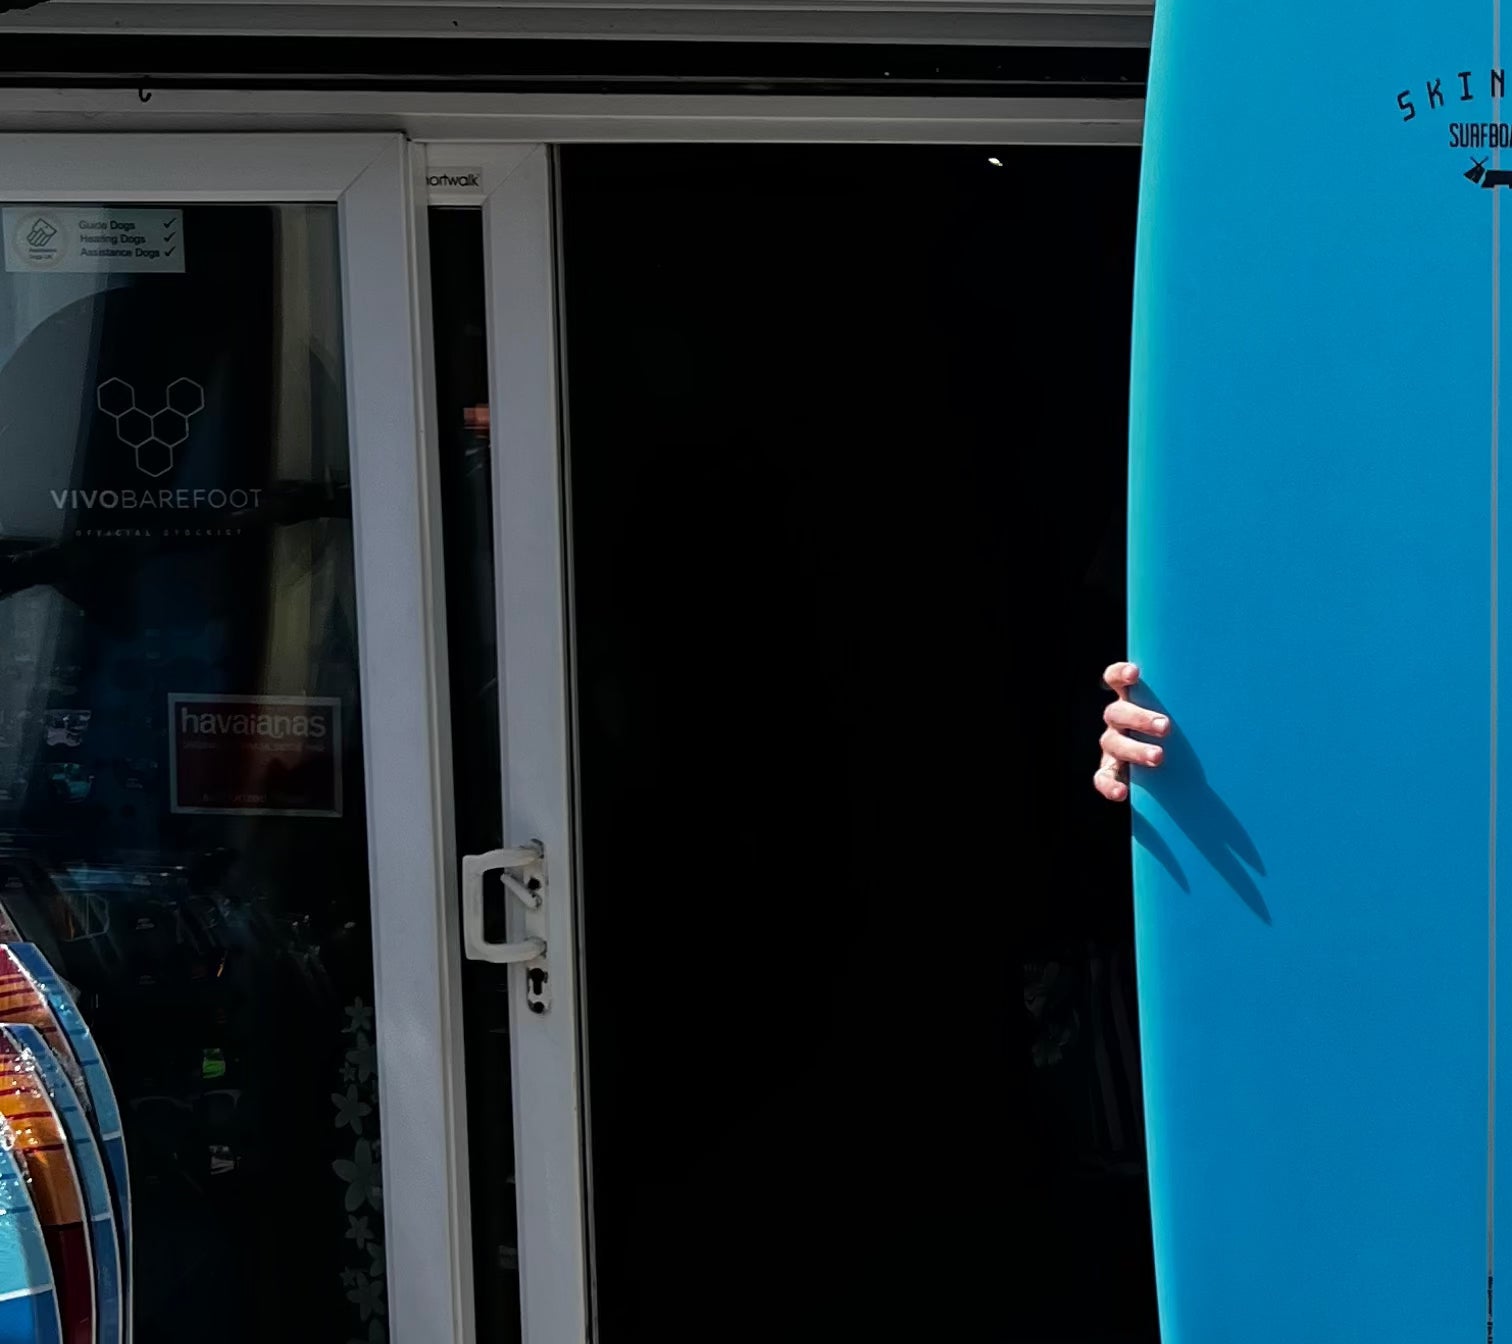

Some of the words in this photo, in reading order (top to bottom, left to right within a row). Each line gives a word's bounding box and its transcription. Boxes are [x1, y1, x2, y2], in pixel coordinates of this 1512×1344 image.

[109, 221, 136, 233] Dogs
[120, 234, 147, 245] Dogs
[135, 248, 161, 259] Dogs
[180, 706, 327, 739] havaianas
